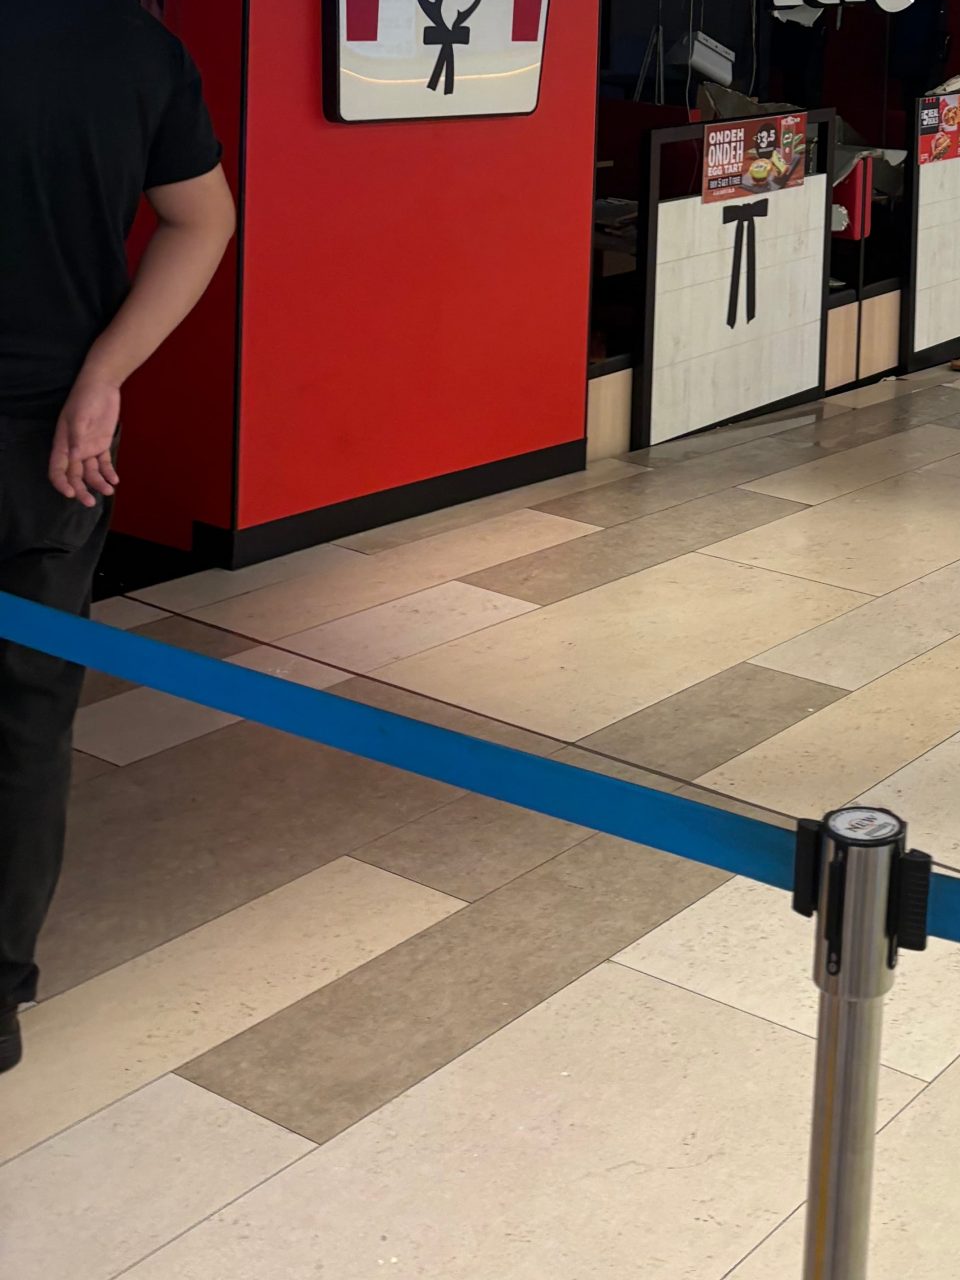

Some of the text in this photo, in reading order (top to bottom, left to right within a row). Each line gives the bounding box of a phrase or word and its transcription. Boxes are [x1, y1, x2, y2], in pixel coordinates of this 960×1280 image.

[708, 128, 745, 144] ONDEH
[708, 141, 744, 166] ONDEH
[707, 163, 743, 177] EGG TART
